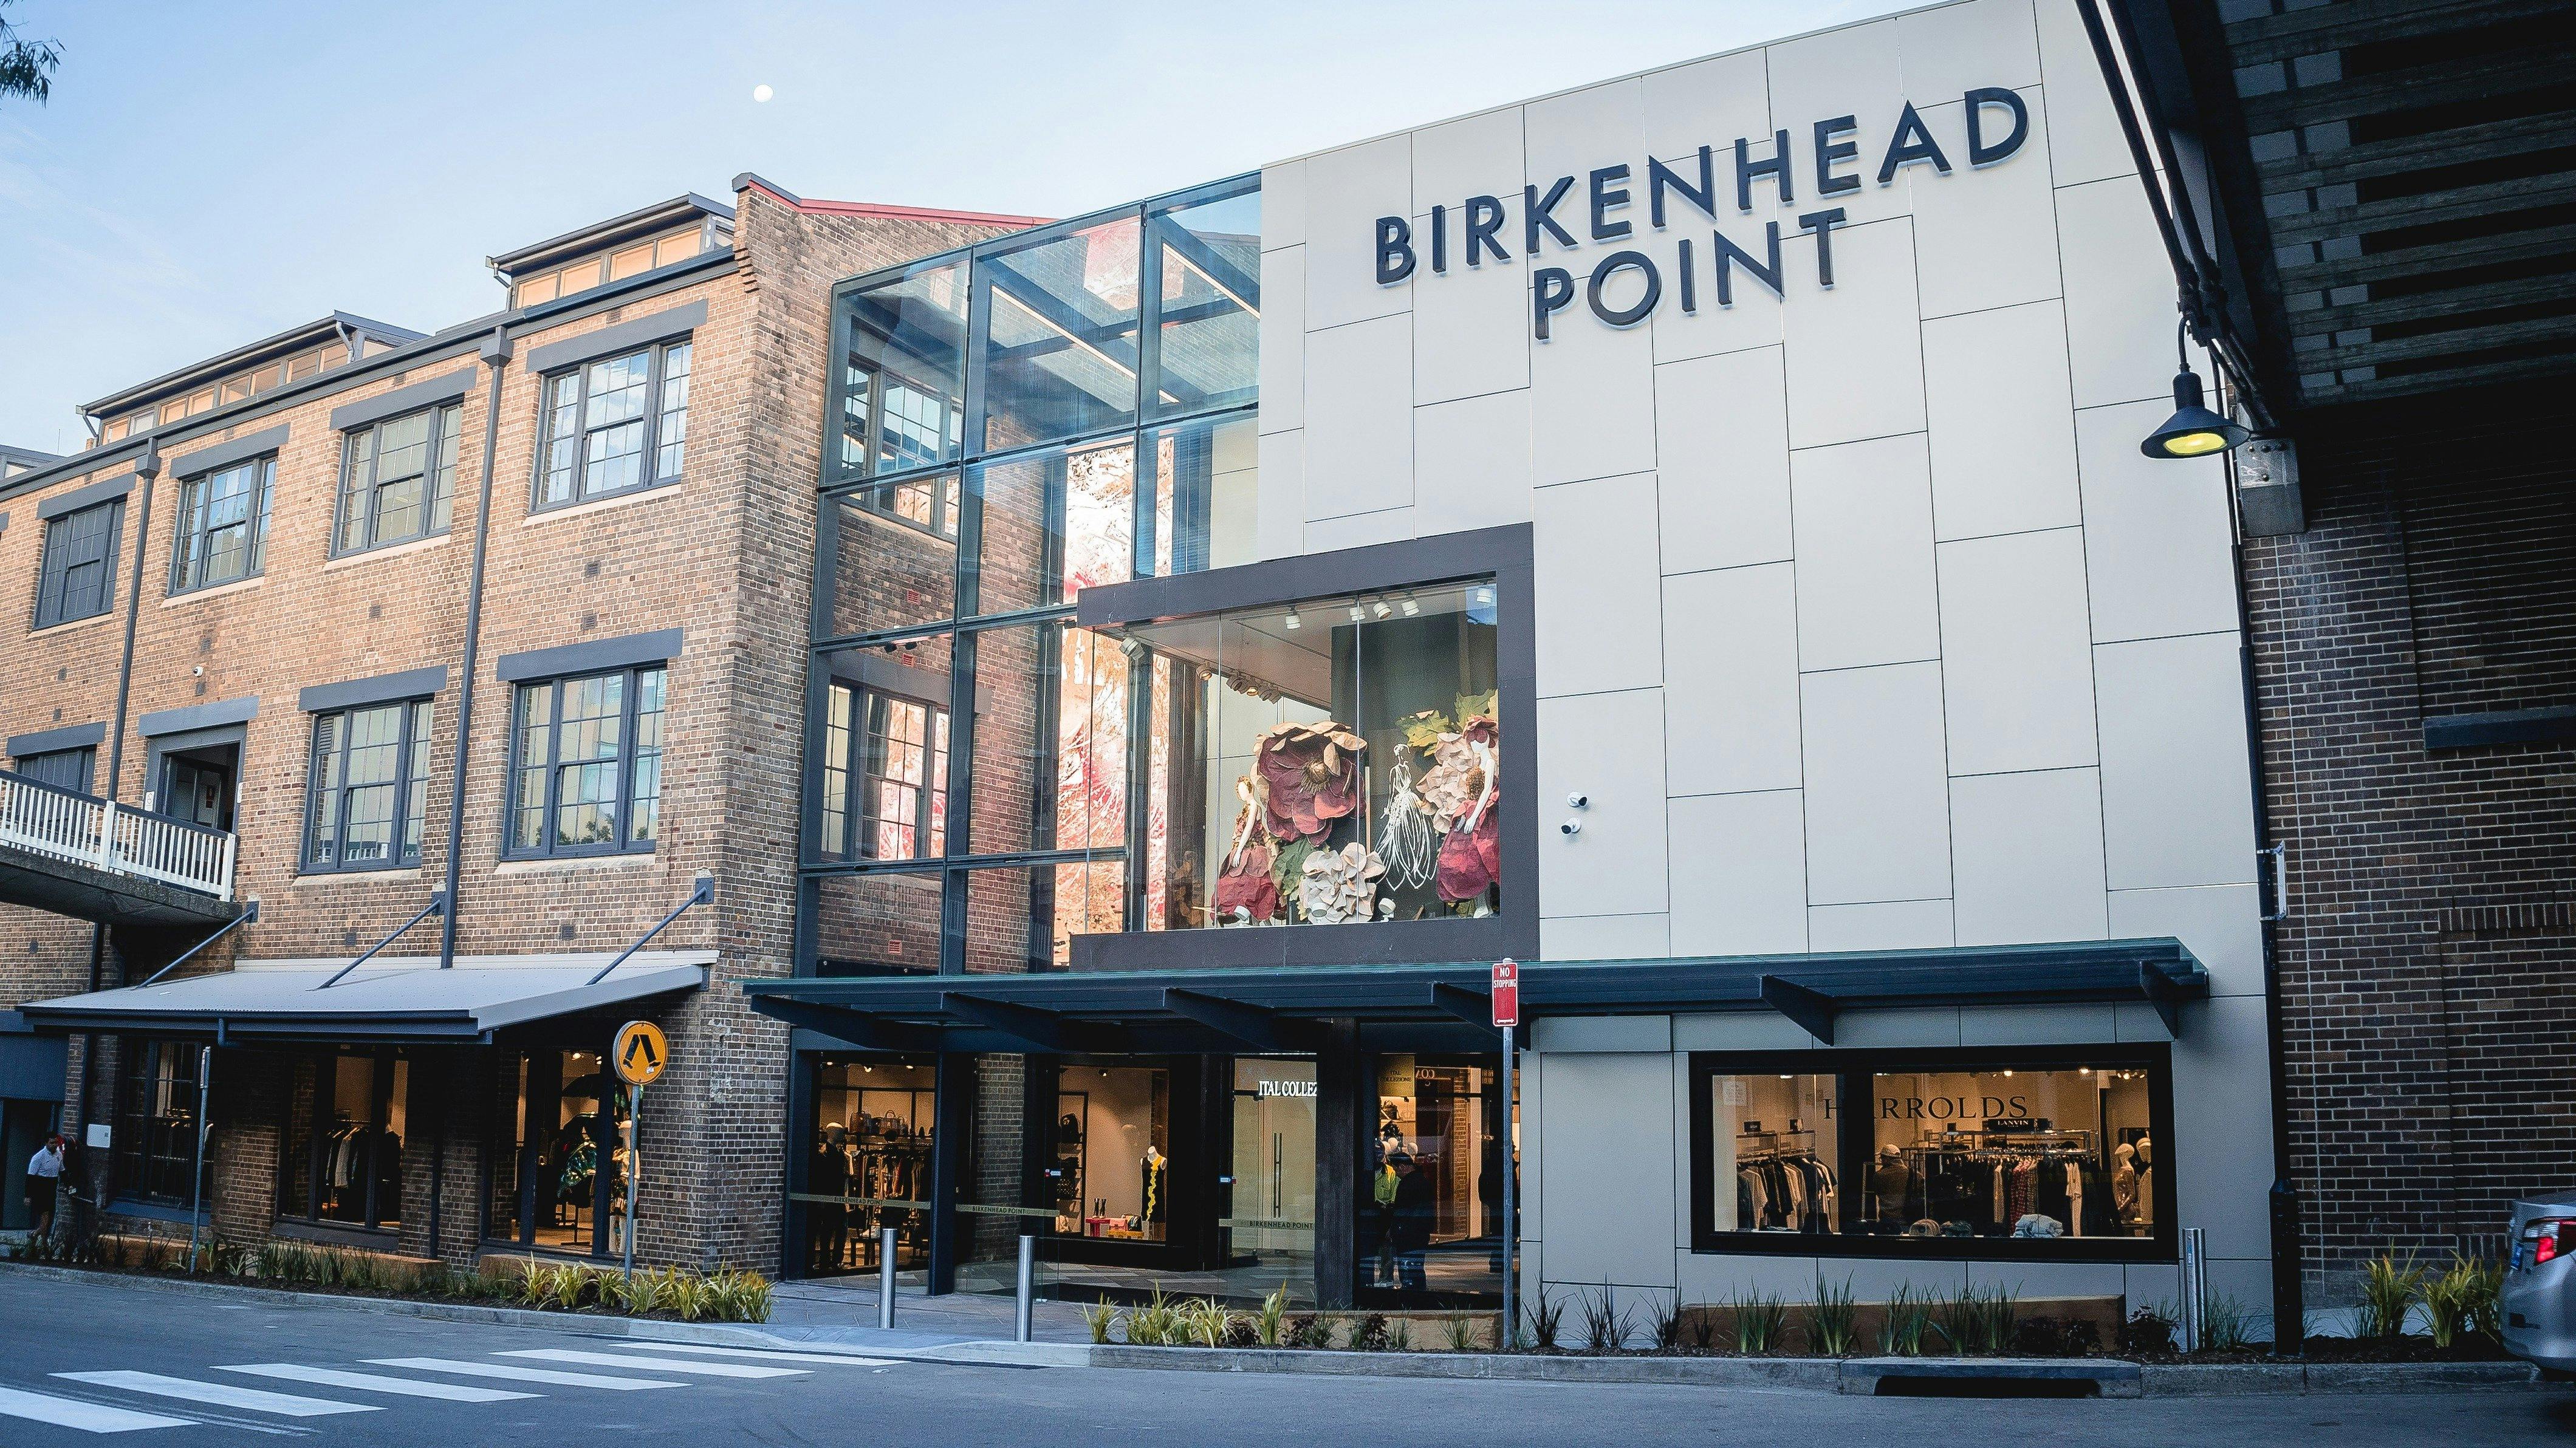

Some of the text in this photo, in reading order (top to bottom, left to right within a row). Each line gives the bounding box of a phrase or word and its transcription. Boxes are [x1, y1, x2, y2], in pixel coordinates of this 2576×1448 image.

[1375, 87, 2030, 285] BIRKENHEAD
[1533, 207, 1847, 341] POINT
[1499, 967, 1510, 977] NO
[1494, 979, 1516, 988] STOPPING
[1258, 1081, 1281, 1096] ITAL
[1823, 1096, 2028, 1119] HRROLDS
[1249, 1220, 1291, 1229] BIRKENHEAD
